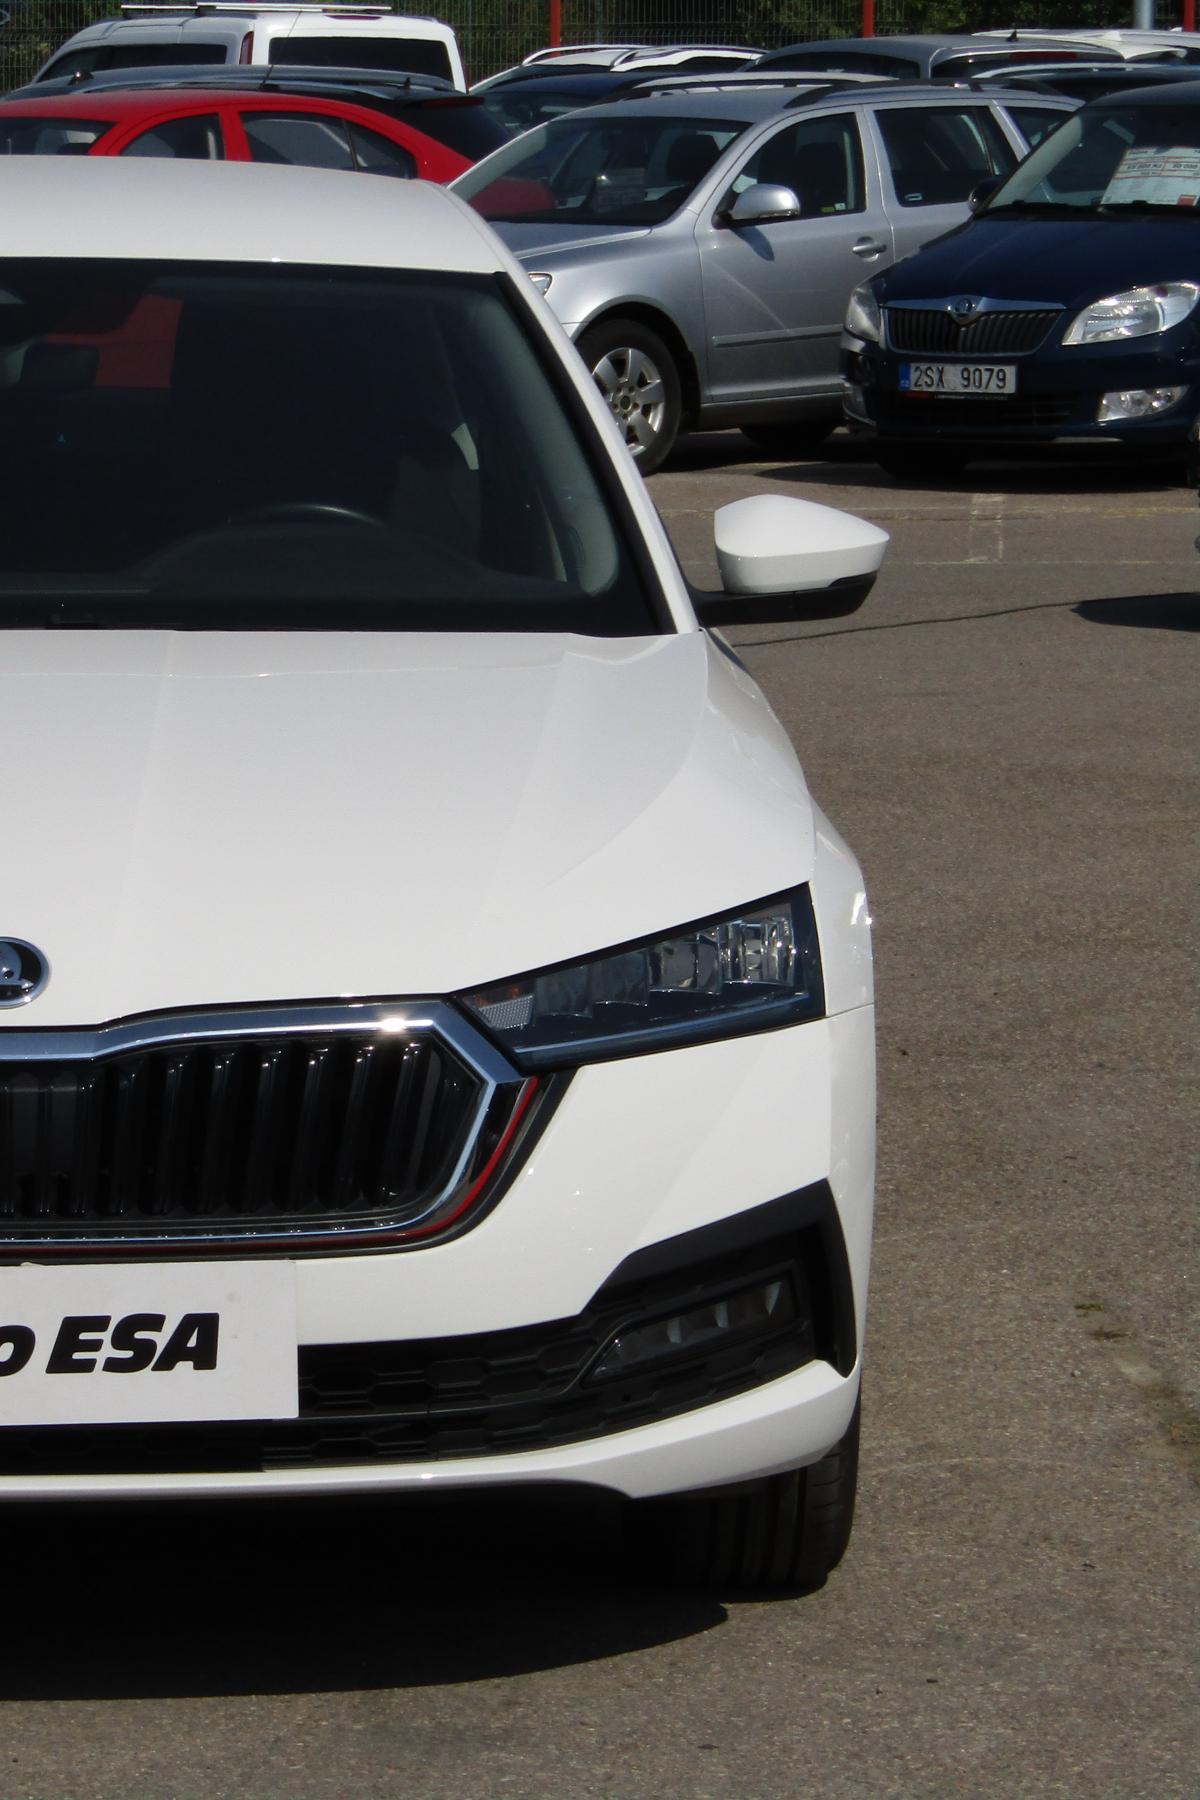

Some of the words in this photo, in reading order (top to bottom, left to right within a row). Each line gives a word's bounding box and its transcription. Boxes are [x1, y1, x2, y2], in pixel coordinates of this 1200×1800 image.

[913, 366, 945, 388] 2SX
[961, 367, 1007, 389] 9079
[45, 1312, 220, 1374] ESA
